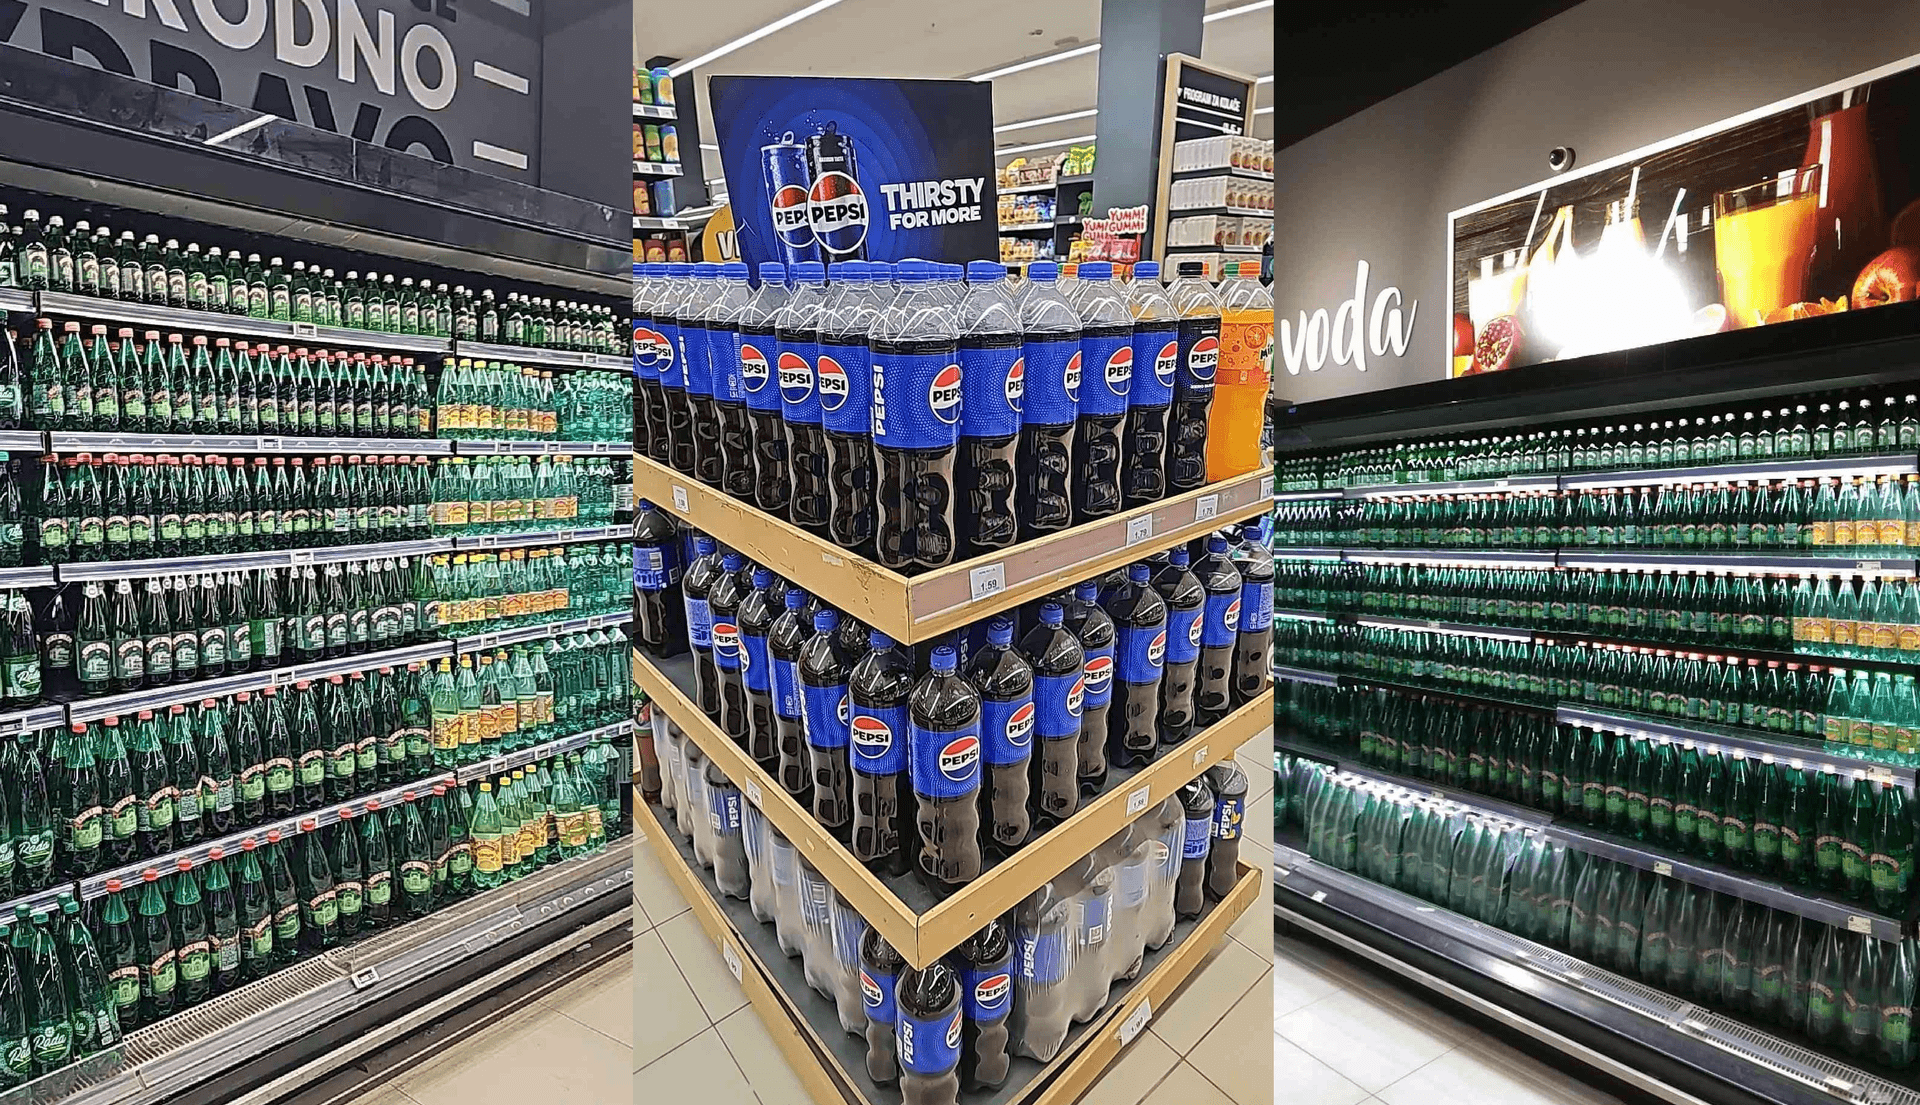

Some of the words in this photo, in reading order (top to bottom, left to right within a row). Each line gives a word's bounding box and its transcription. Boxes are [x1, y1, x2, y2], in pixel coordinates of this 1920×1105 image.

[879, 177, 985, 212] THIRSTY
[811, 203, 865, 224] PEPSI
[889, 211, 929, 231] FOR
[931, 205, 982, 226] MORE
[1110, 207, 1146, 221] YUMM!
[1281, 260, 1418, 375] voda
[743, 362, 766, 374] EPSI
[819, 375, 846, 391] EPSI
[872, 364, 886, 436] PEPSI
[853, 728, 889, 743] PEPSI
[1009, 714, 1035, 734] PEPS
[942, 749, 979, 767] PEPSI
[727, 796, 741, 829] PEPSI
[1220, 804, 1233, 836] PEPSI
[1023, 939, 1035, 978] PEPSI
[977, 983, 1009, 998] PEPSI
[903, 1019, 914, 1065] PEPSI
